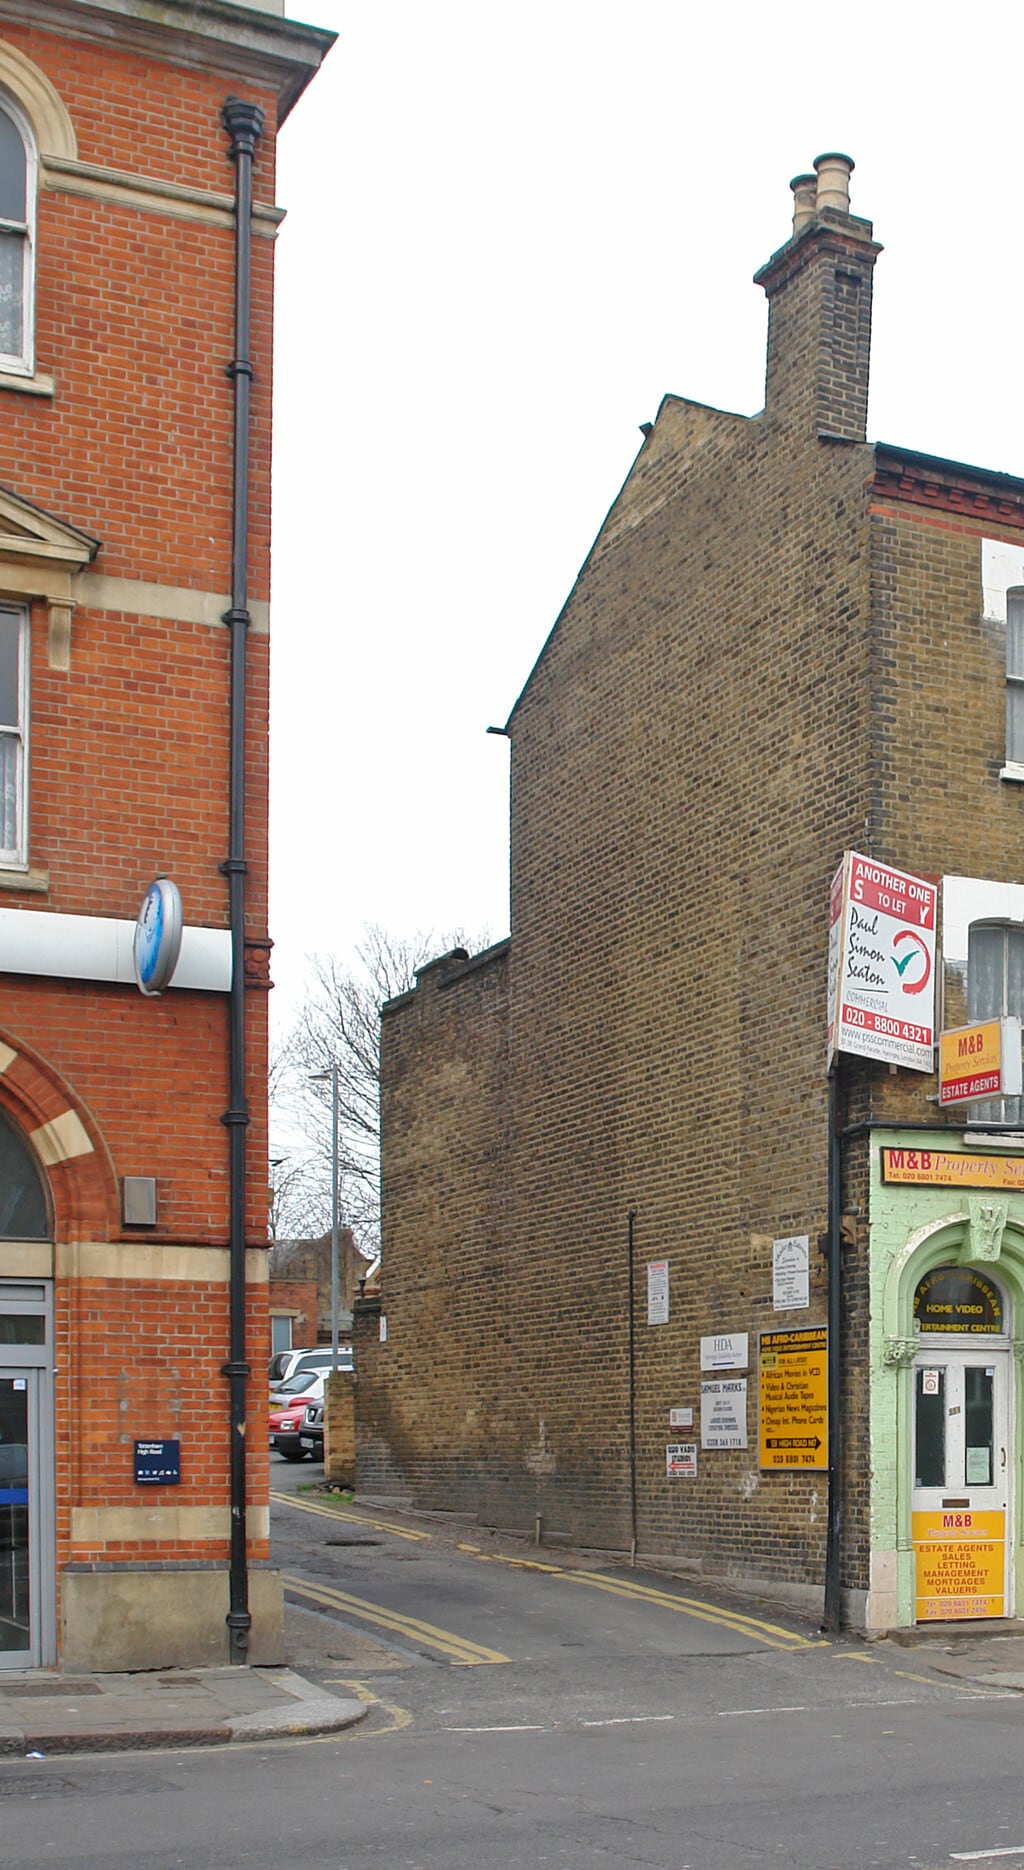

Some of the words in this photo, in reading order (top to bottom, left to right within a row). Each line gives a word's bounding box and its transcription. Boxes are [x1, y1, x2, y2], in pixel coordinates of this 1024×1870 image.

[856, 863, 906, 895] ANOTHER
[908, 885, 931, 904] ONE
[878, 892, 890, 907] TO
[892, 898, 906, 914] LET
[849, 907, 878, 935] Paul
[848, 932, 885, 962] Simon
[847, 956, 885, 985] Seaton
[846, 990, 888, 1012] COMMERCIAL
[846, 1007, 865, 1026] 020
[874, 1015, 900, 1036] 8800
[902, 1024, 928, 1043] 4321
[841, 1027, 932, 1058] www.psscommercial.com
[958, 1033, 983, 1057] M&B
[942, 1082, 968, 1099] ESTATE
[969, 1075, 999, 1092] AGENTS
[889, 1150, 931, 1170] M&B
[934, 1154, 998, 1178] Property
[902, 1172, 915, 1180] 020
[917, 1173, 933, 1181] 8801
[935, 1174, 952, 1182] 7474
[926, 1304, 953, 1314] HOME
[954, 1304, 983, 1314] VIDEO
[921, 1322, 970, 1331] ERTAINMENT
[970, 1323, 1000, 1332] CENTRE
[714, 1338, 733, 1352] HDA
[765, 1371, 783, 1379] African
[766, 1382, 779, 1391] Video
[786, 1381, 809, 1390] Christian
[786, 1404, 800, 1412] News
[773, 1455, 783, 1463] 020
[943, 1514, 972, 1528] M&B
[919, 1545, 954, 1553] ESTATE
[957, 1544, 994, 1552] AGENTS
[942, 1553, 972, 1561] SALES
[937, 1561, 976, 1569] LETTING
[923, 1569, 990, 1578] MANAGEMENT
[926, 1577, 986, 1586] MORTGAGES
[935, 1586, 978, 1594] VALUERS
